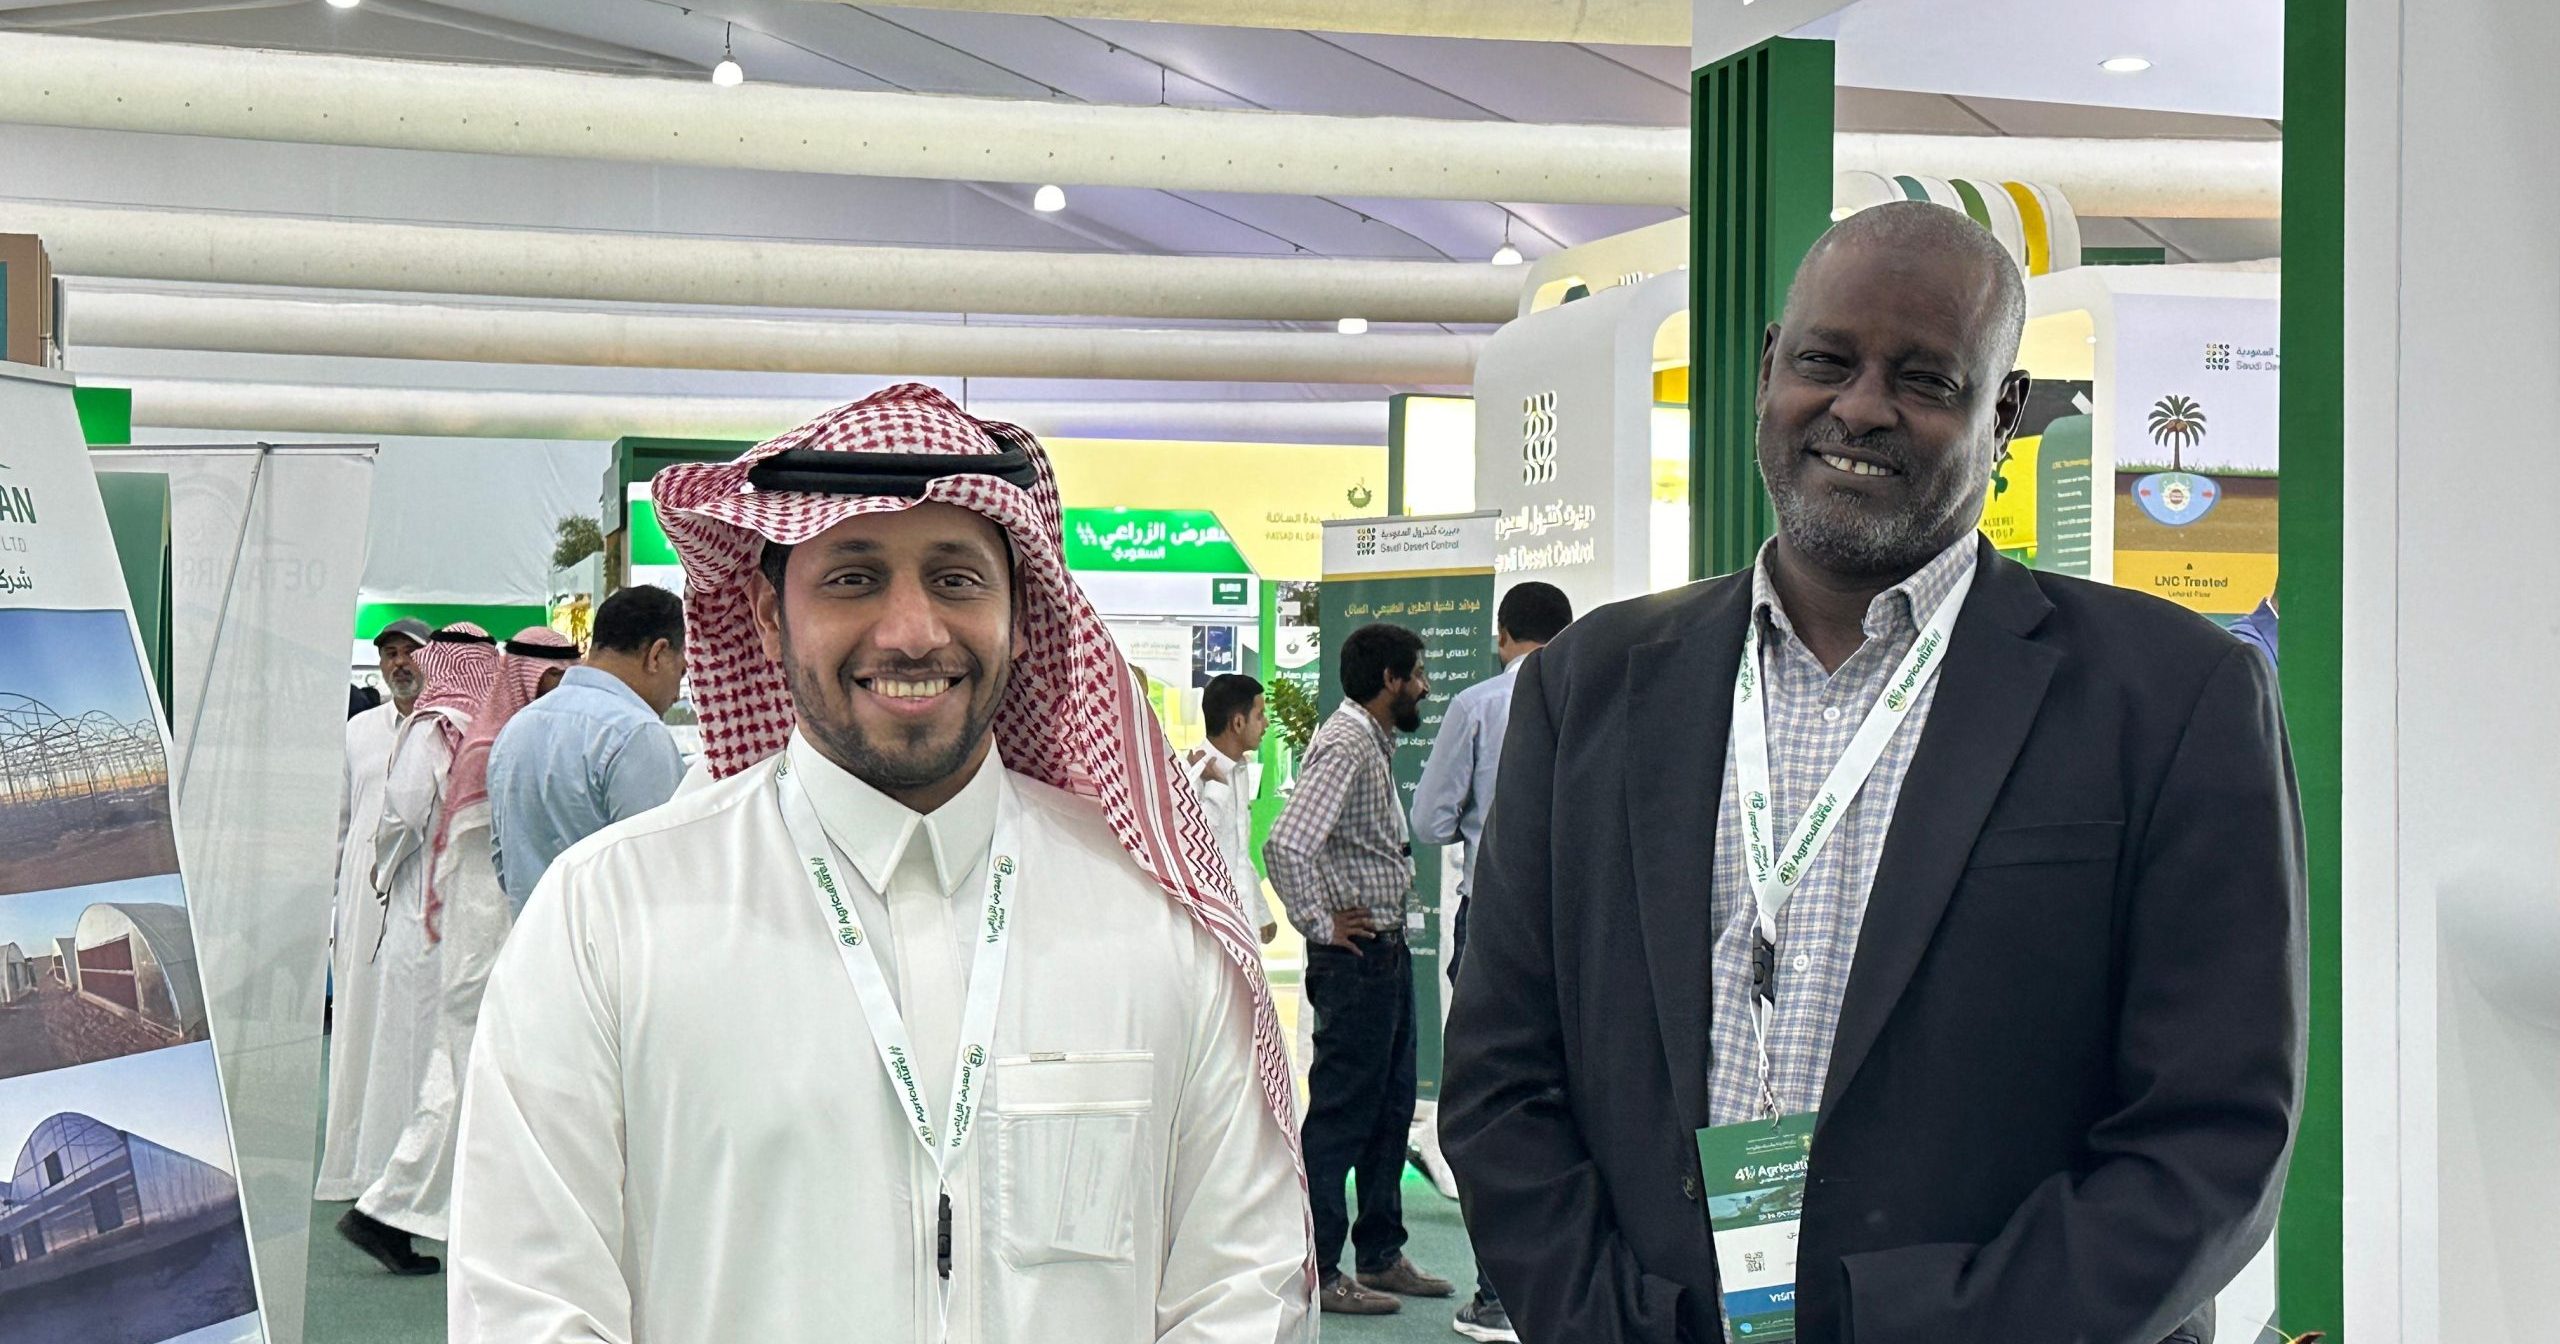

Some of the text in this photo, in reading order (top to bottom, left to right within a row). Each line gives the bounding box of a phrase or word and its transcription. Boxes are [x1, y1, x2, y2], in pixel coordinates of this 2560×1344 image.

[2, 537, 27, 552] LTD
[1985, 528, 2014, 539] ROUP
[1554, 537, 1595, 567] Control
[2155, 575, 2229, 587] LNC Treated
[1900, 639, 1938, 693] Agriculture
[1792, 804, 1832, 865] Agriculture
[819, 864, 851, 925] Agriculture
[897, 1055, 926, 1123] Agriculture
[1758, 1160, 1809, 1178] Agricult
[1769, 1290, 1795, 1303] VISIT
